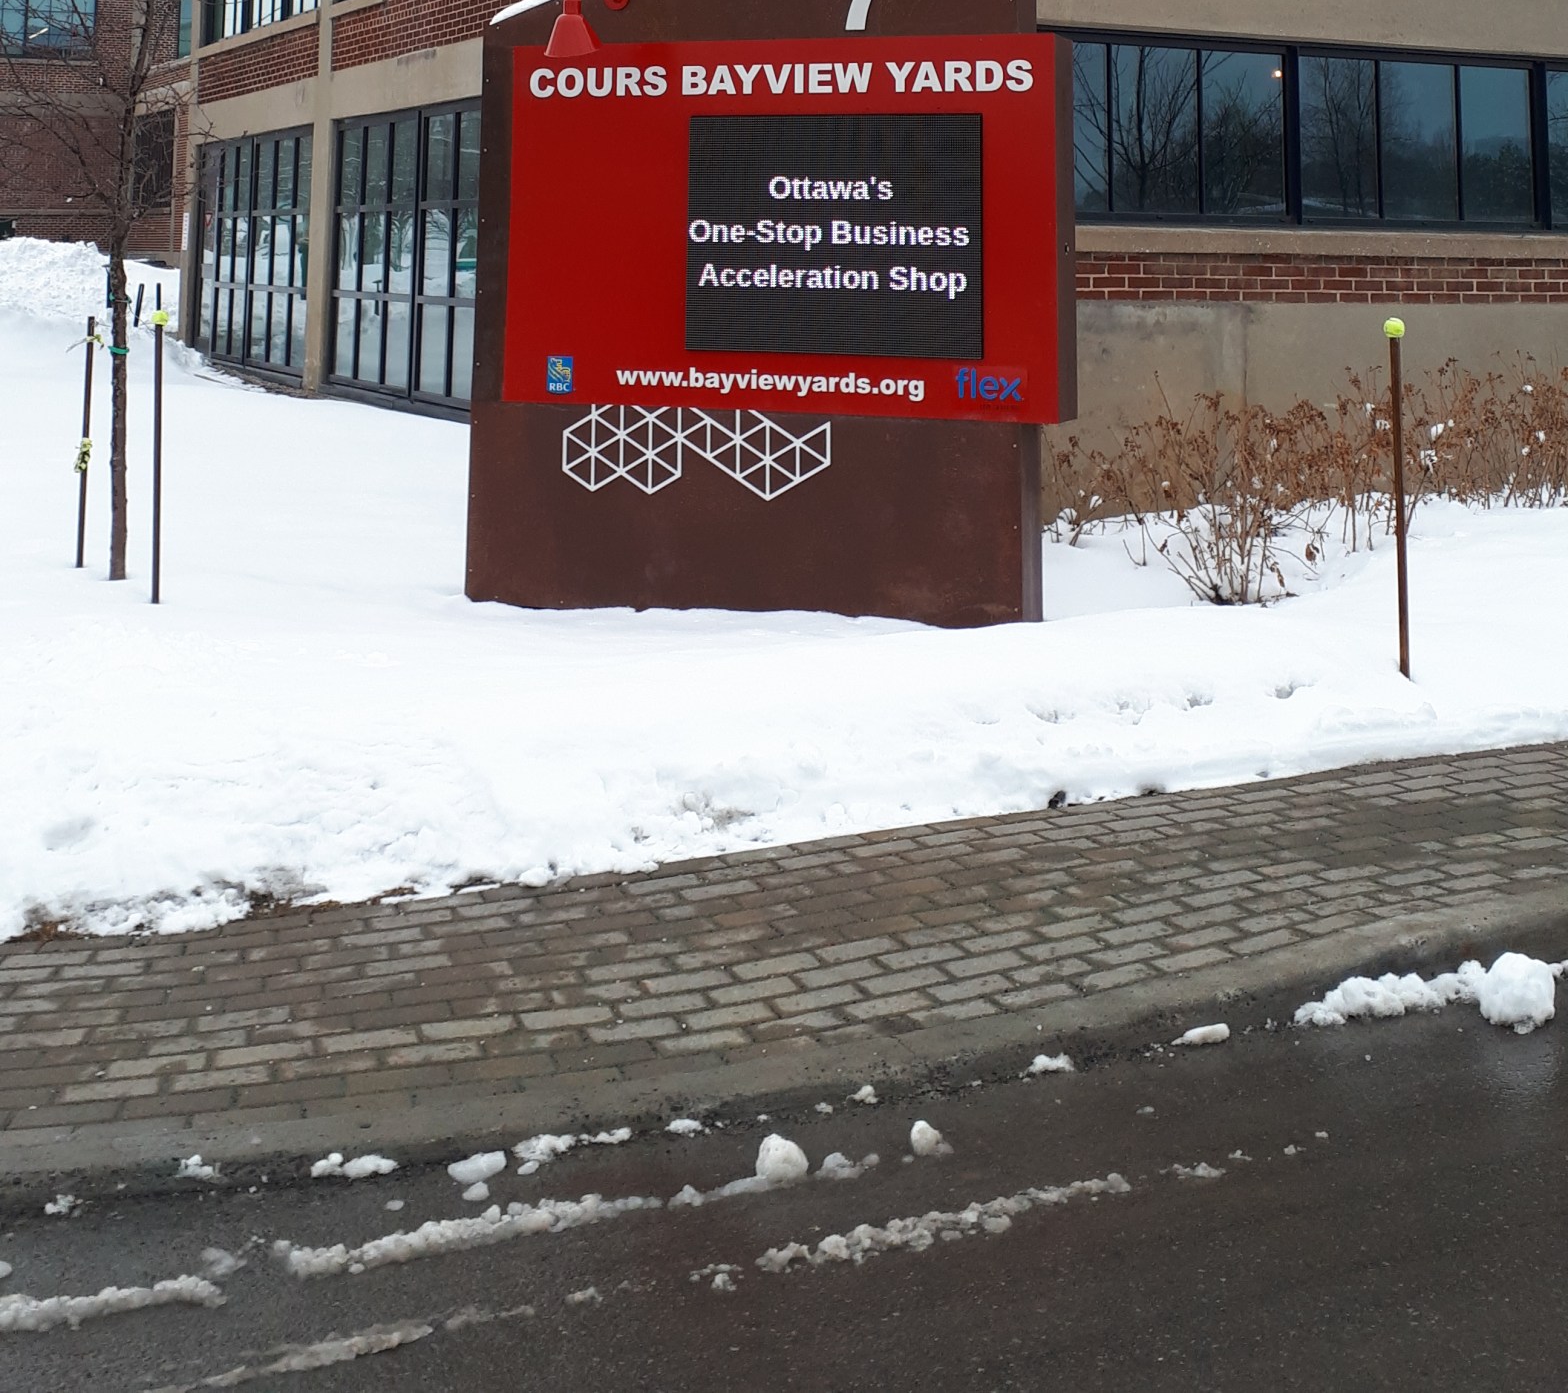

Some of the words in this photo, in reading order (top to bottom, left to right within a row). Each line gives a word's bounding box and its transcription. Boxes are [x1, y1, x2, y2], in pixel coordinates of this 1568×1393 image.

[529, 65, 668, 98] COURS
[682, 62, 873, 96] BAYVIEW
[886, 59, 1034, 93] YARDS
[768, 176, 894, 201] Ottawa's
[688, 219, 823, 251] One-Stop
[831, 220, 970, 246] Business
[698, 263, 880, 290] Acceleration
[889, 266, 968, 300] Shop
[549, 382, 571, 392] RBC
[616, 367, 925, 402] www.bayviewyards.org
[955, 367, 1022, 402] flex
